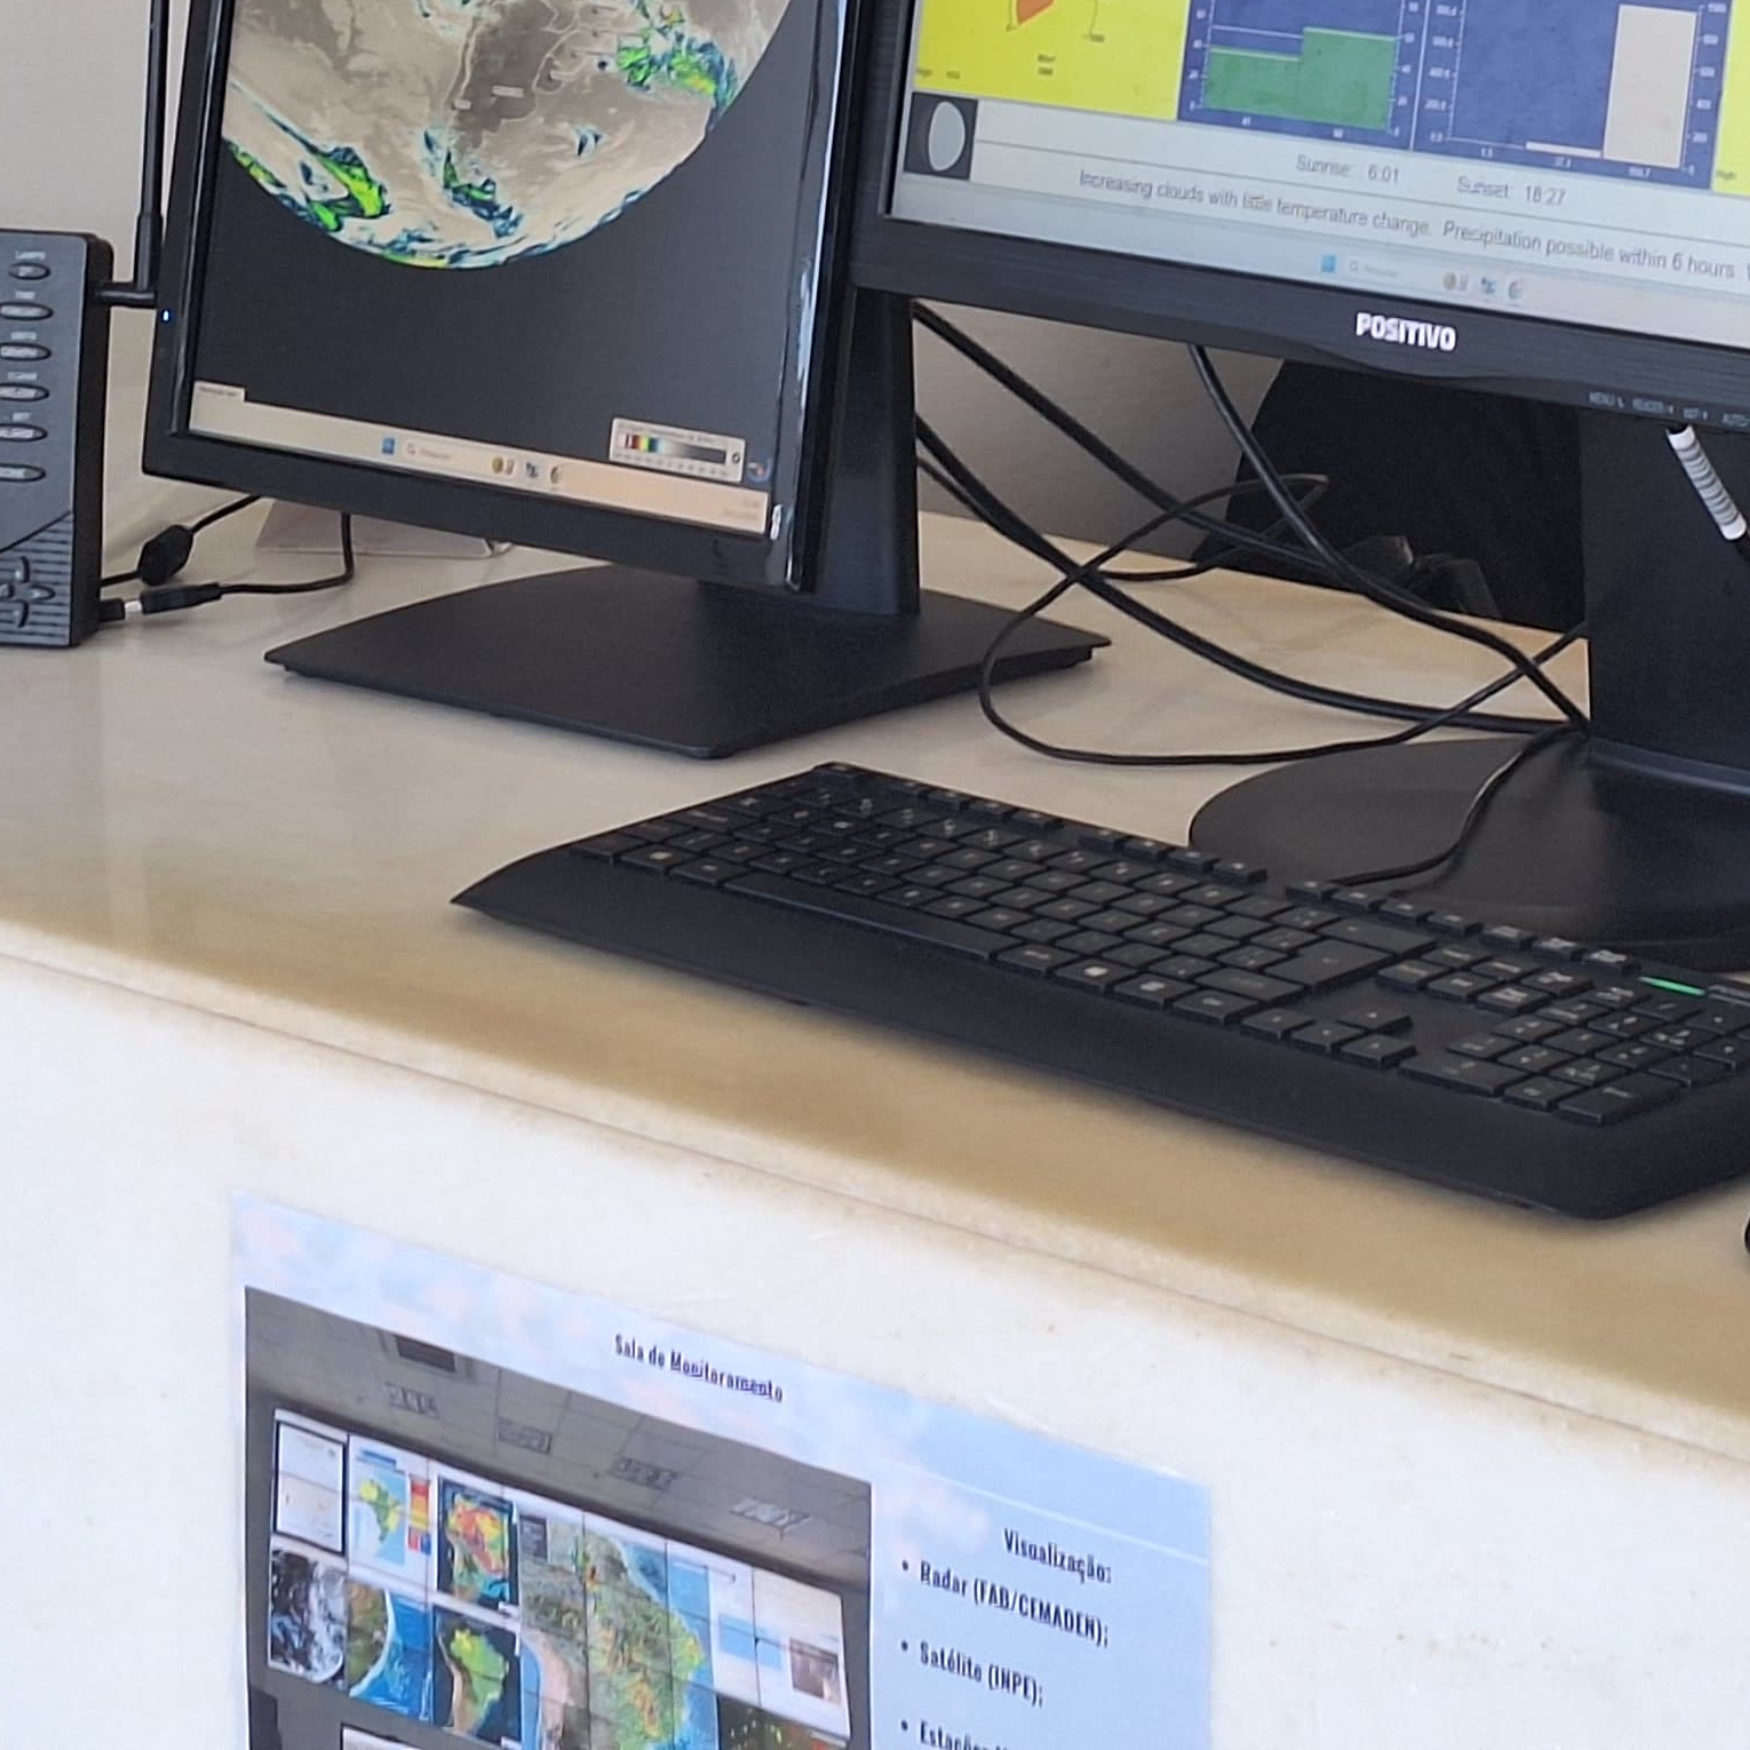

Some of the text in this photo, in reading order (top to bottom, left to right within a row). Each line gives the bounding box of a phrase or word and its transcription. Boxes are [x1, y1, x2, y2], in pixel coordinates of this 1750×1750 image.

[1080, 170, 1152, 200] Increasing
[1157, 181, 1203, 203] clouds
[1208, 189, 1238, 208] with
[1277, 199, 1368, 228] temperature
[1444, 220, 1541, 250] Precipitation
[1546, 236, 1614, 262] possible
[1619, 249, 1666, 268] within
[1672, 253, 1682, 271] 6
[1356, 312, 1456, 351] POSITIVO
[615, 1333, 783, 1403] Sala de Monitoramento
[1004, 1528, 1111, 1584] Visualização:
[920, 1560, 1108, 1648] Radar (FAB/CEMADEN);
[920, 1641, 1043, 1708] Satélite (INPE);
